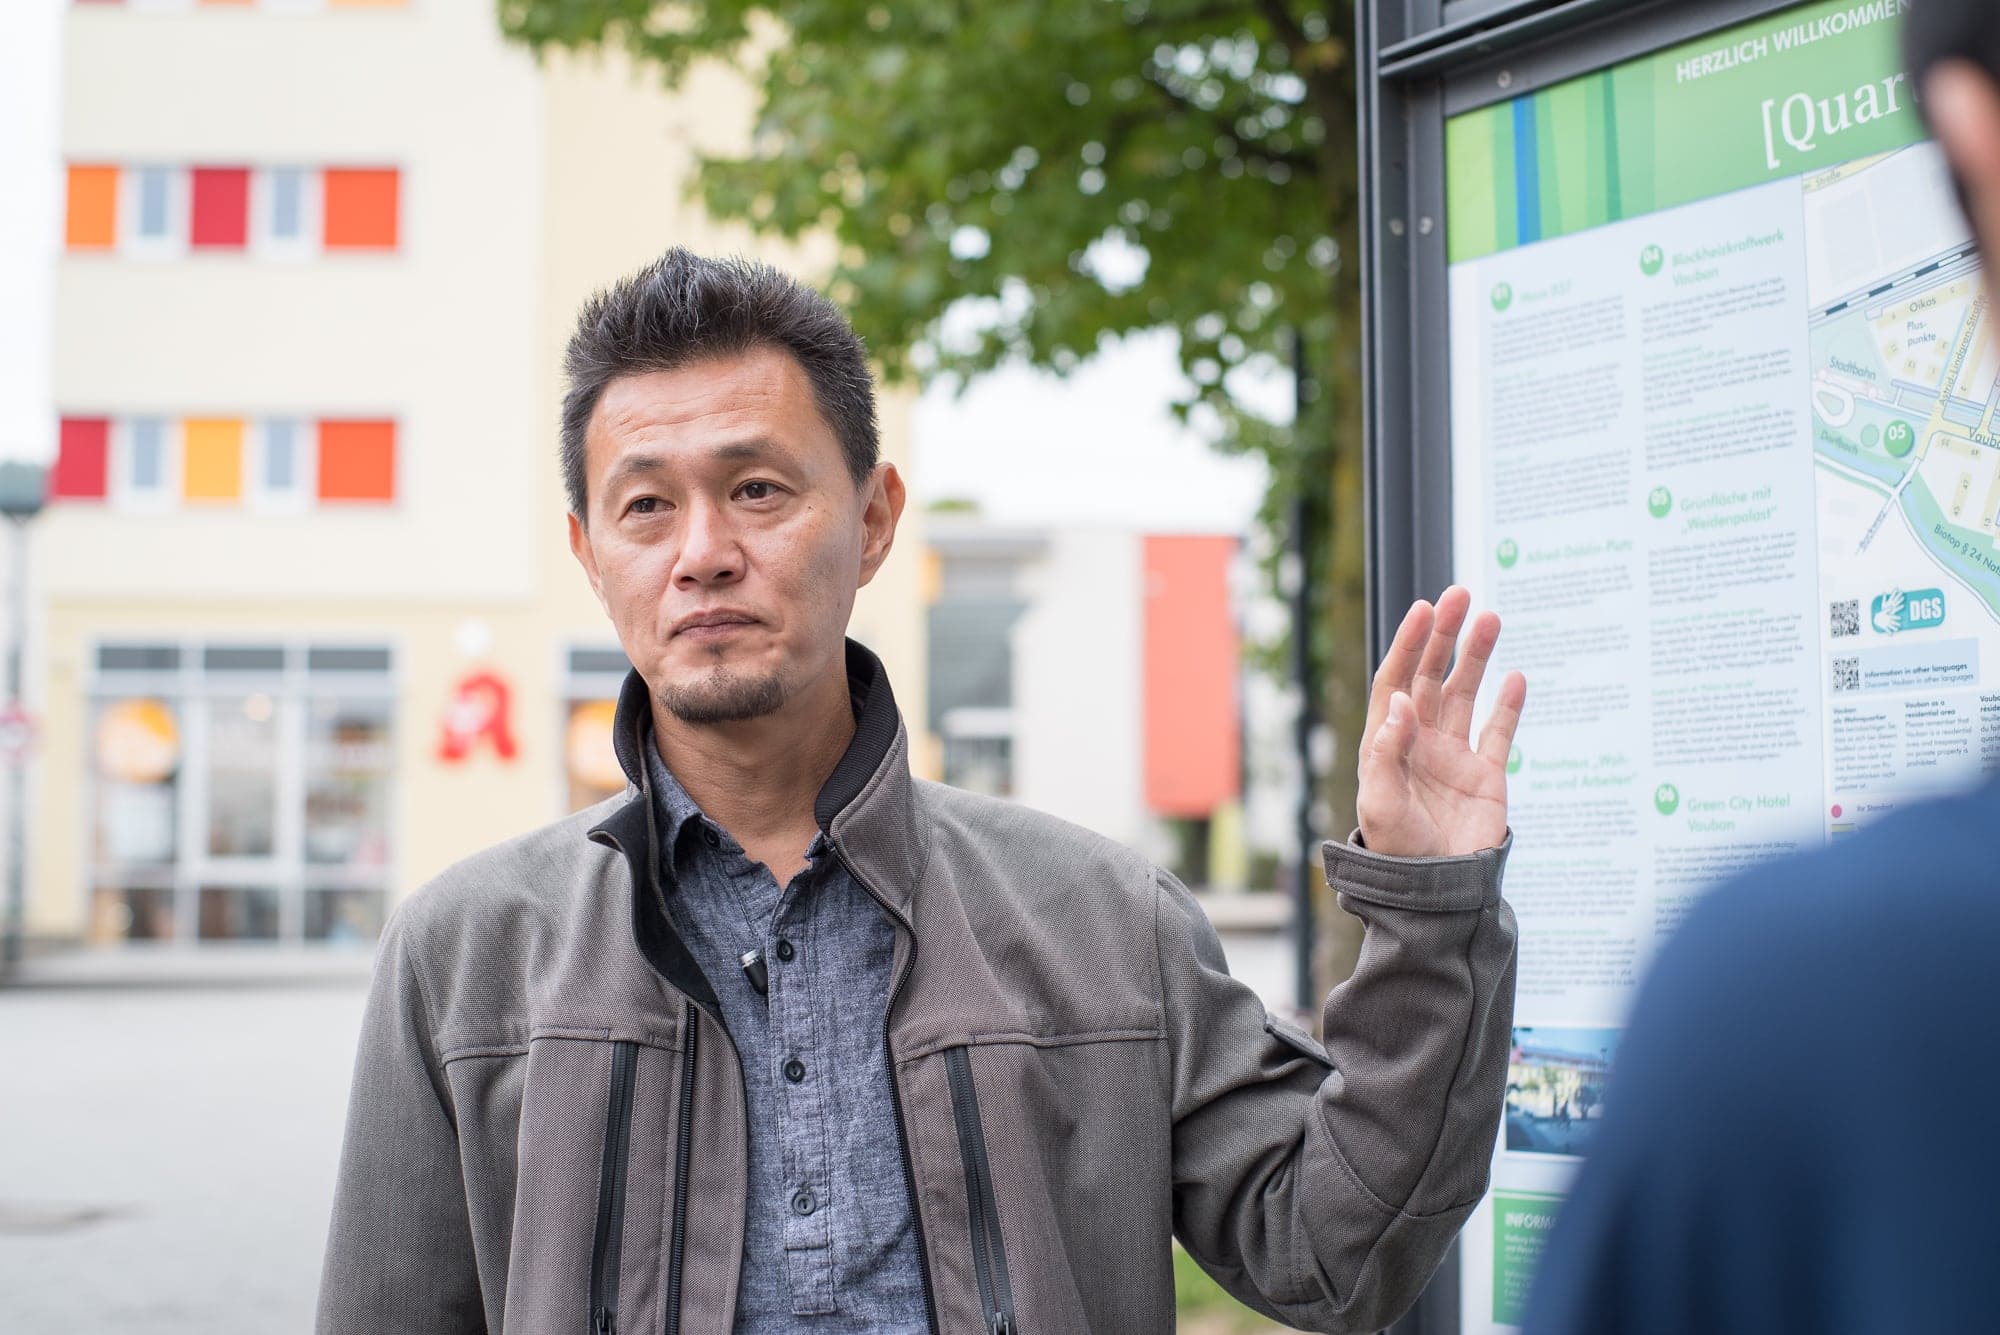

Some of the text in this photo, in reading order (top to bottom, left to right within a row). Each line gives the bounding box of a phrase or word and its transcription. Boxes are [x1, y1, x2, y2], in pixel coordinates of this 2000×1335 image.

[1675, 36, 1768, 84] HERZLICH
[1761, 72, 1905, 170] [Quar
[1909, 297, 1937, 313] Oikos
[1907, 332, 1937, 348] punkte
[1828, 355, 1877, 381] Stadtbahn
[1887, 423, 1907, 441] 05
[1933, 523, 1961, 549] Biotop
[1961, 542, 1970, 555] §
[1969, 547, 1982, 562] 24
[1908, 597, 1943, 622] DGS
[1864, 668, 1903, 679] Information
[1912, 665, 1931, 676] other
[1931, 662, 1968, 674] languages
[1940, 673, 1974, 684] languages
[1687, 798, 1726, 814] Green
[1729, 795, 1754, 812] City
[1756, 792, 1791, 809] Hotel
[1687, 818, 1736, 834] Vauban
